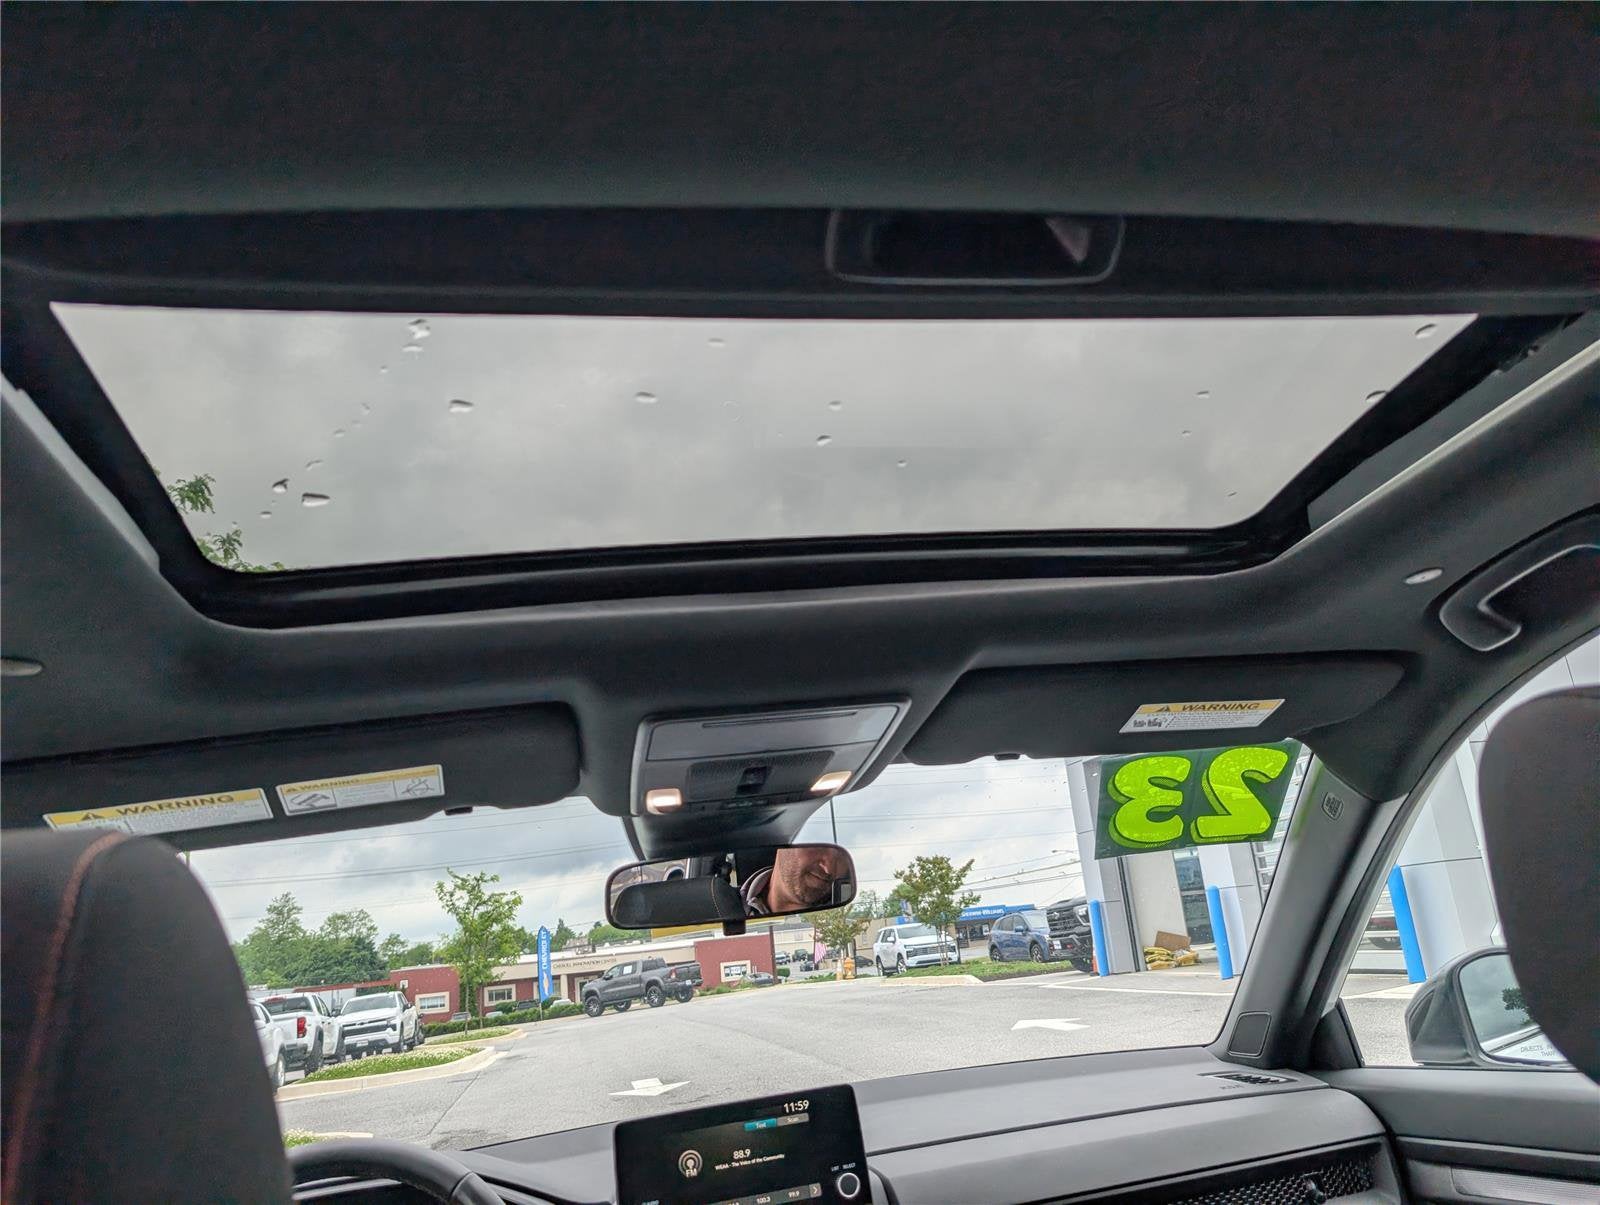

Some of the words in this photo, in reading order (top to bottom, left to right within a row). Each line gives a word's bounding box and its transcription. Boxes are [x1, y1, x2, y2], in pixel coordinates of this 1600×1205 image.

[1182, 702, 1260, 712] WARNING
[300, 779, 360, 791] WARNING
[116, 794, 235, 816] WARNING
[783, 1100, 810, 1114] 11:59
[732, 1149, 751, 1160] 88.9
[739, 1159, 752, 1167] Voice
[763, 1153, 785, 1162] Community
[685, 1167, 698, 1178] FM
